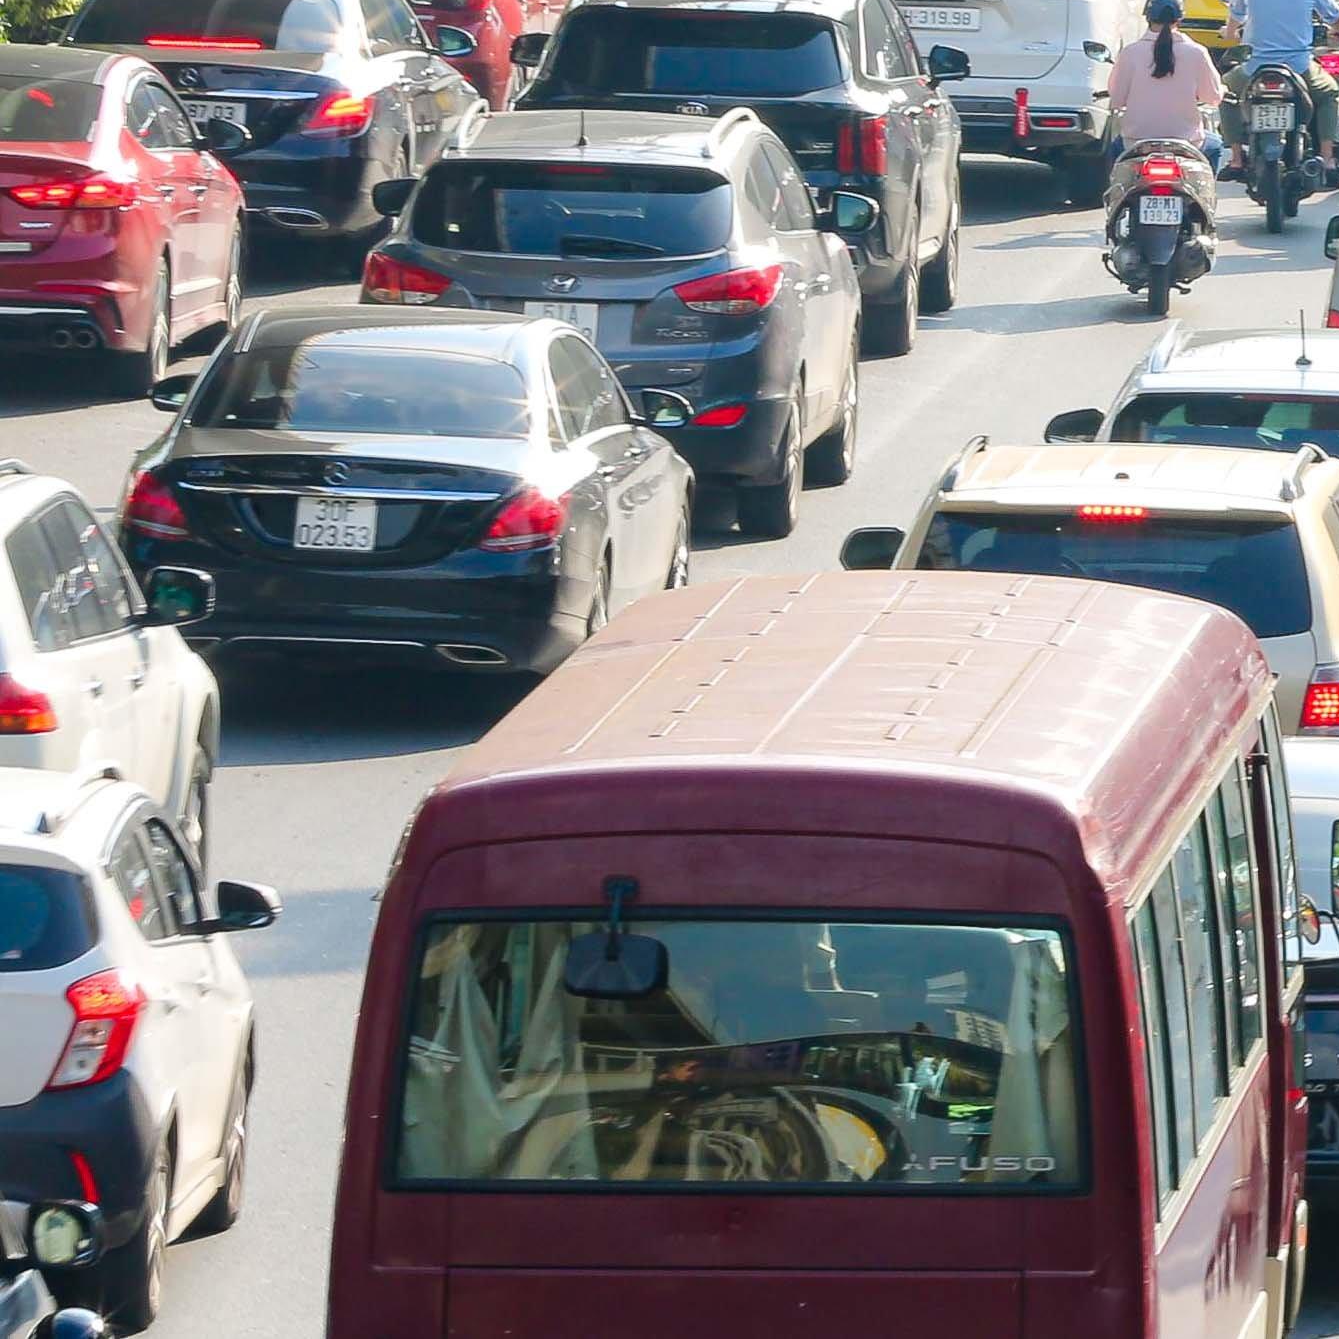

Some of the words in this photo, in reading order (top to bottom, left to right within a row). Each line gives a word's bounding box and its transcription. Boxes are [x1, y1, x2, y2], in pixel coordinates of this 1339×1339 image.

[903, 10, 971, 26] H-319.98
[316, 499, 359, 521] 30F
[298, 523, 369, 547] 023.53
[930, 1156, 1055, 1171] FUSO
